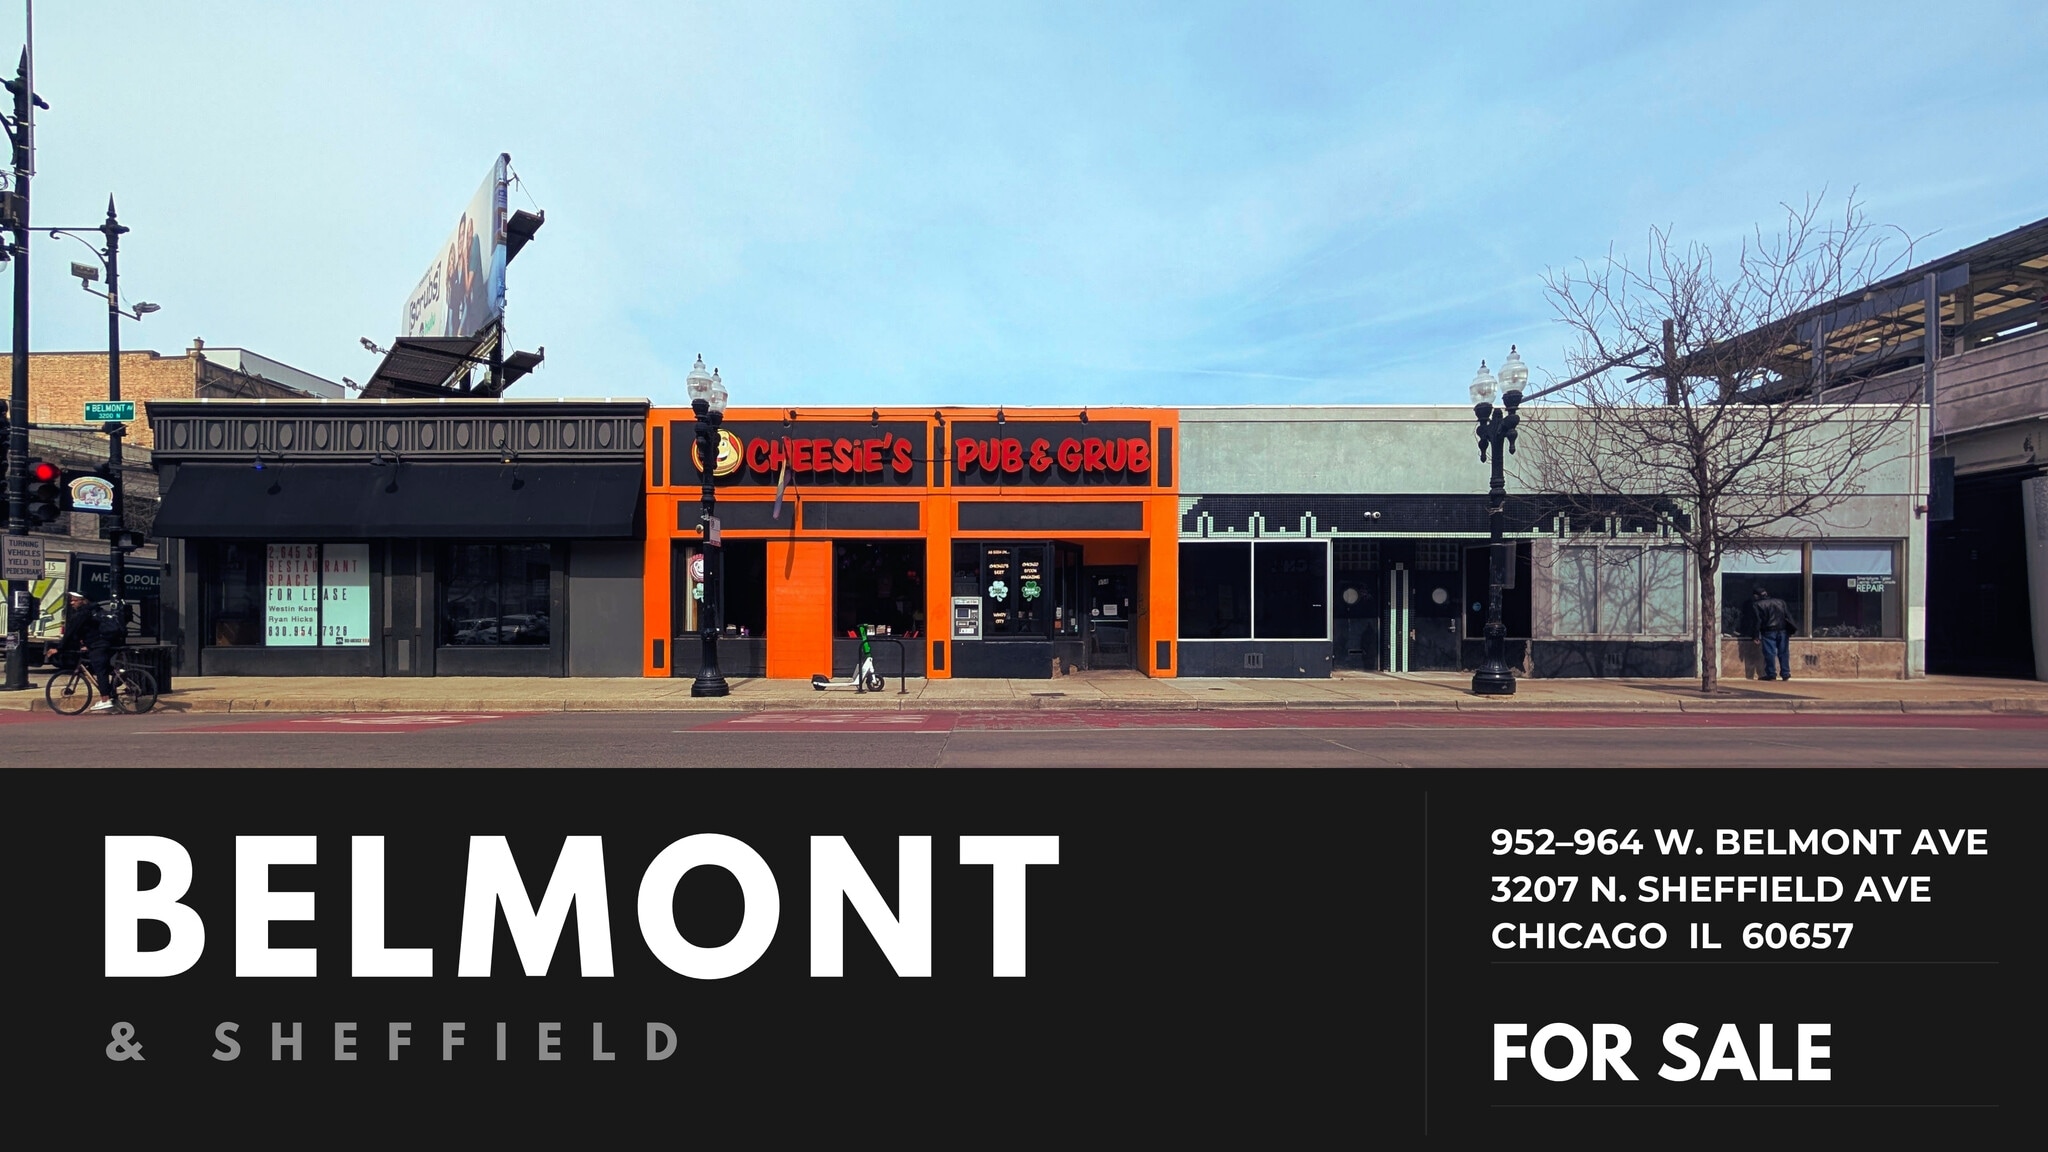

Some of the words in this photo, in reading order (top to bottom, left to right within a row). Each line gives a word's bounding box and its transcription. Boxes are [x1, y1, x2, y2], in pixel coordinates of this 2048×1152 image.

[92, 404, 126, 412] BELMONT
[955, 437, 1024, 473] PUB
[1029, 437, 1054, 468] &
[1058, 437, 1150, 473] GRUB
[9, 540, 39, 548] TURNING
[8, 549, 41, 557] VEHICLES
[8, 558, 28, 566] YIELD
[32, 559, 41, 567] TO
[268, 560, 357, 573] RESTAURANT
[6, 567, 42, 575] PEDESTRIANS
[91, 572, 160, 585] MEOPOLI
[268, 574, 309, 587] SPACE
[1857, 584, 1884, 592] REPAIR
[268, 588, 293, 601] FOR
[303, 588, 347, 601] LEASE
